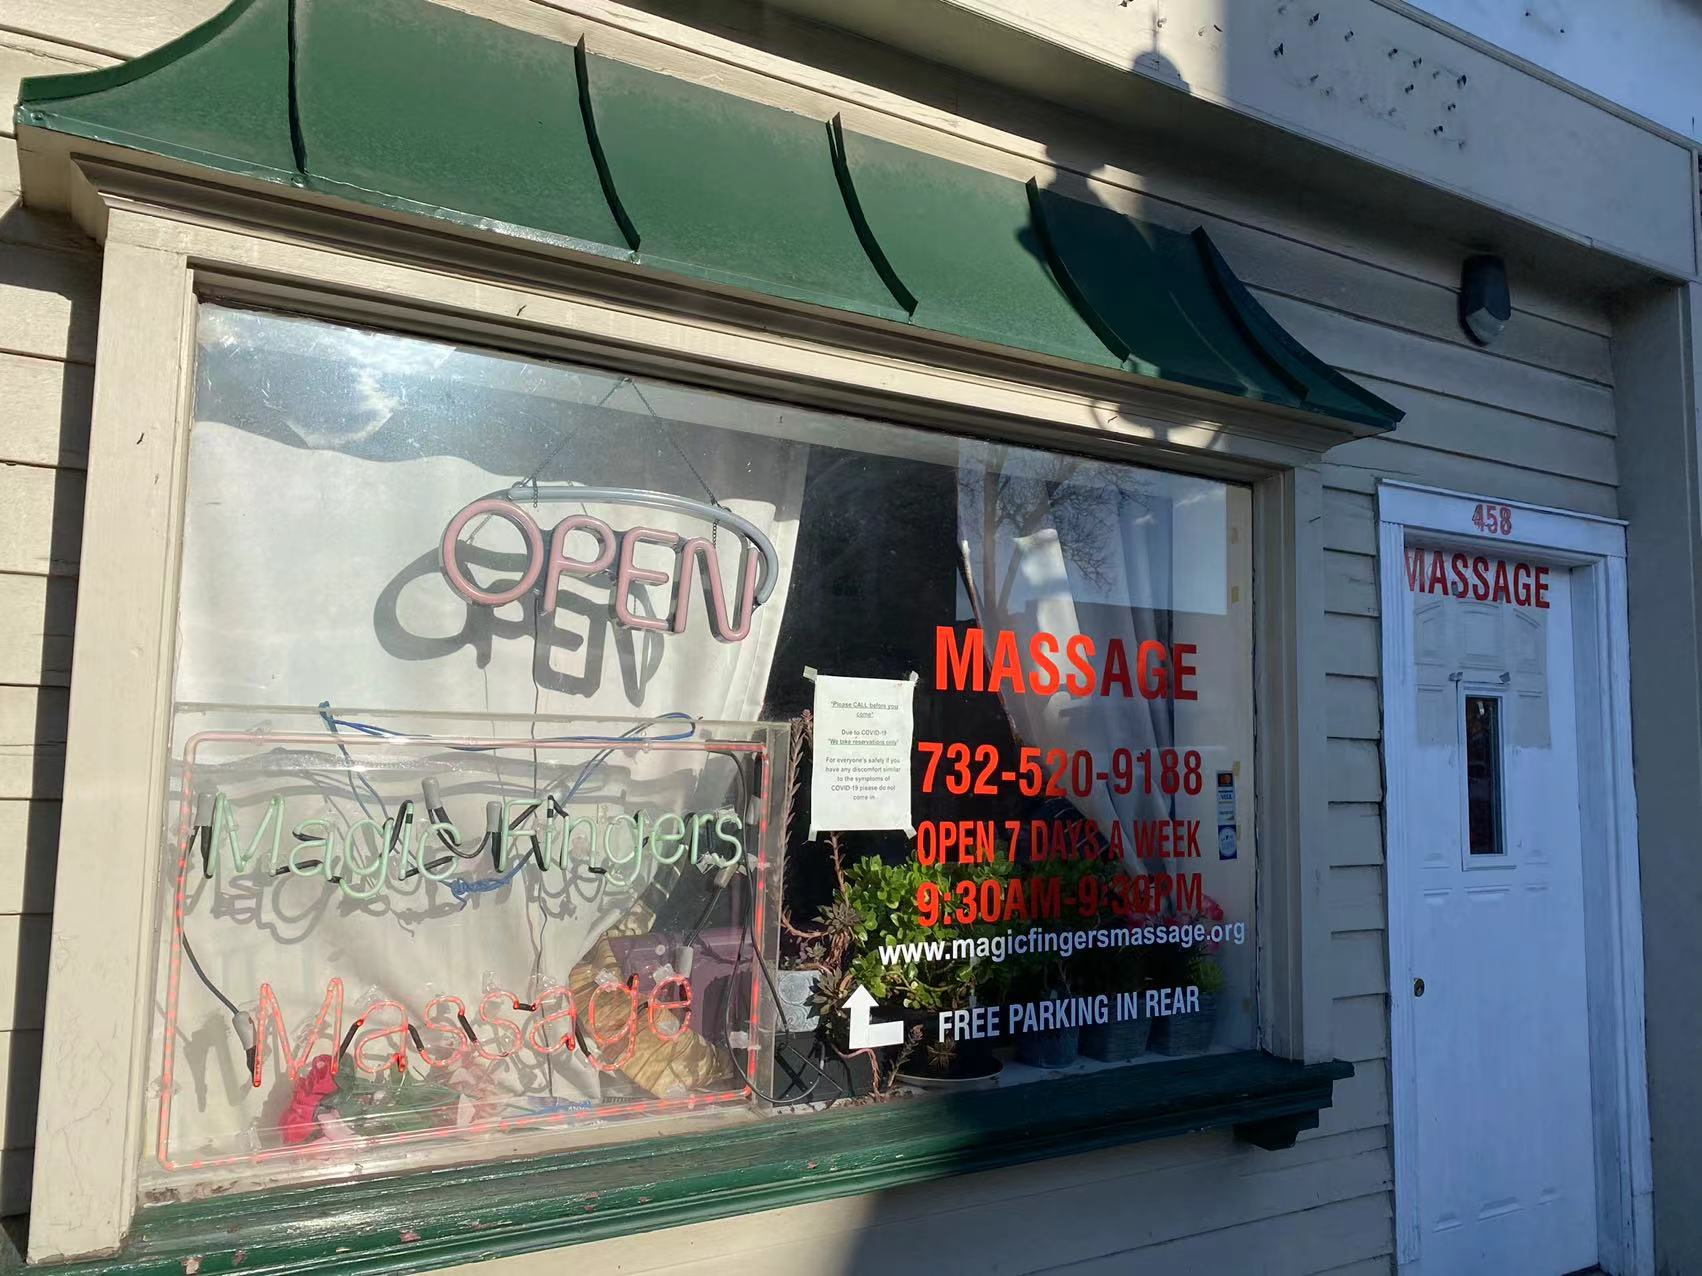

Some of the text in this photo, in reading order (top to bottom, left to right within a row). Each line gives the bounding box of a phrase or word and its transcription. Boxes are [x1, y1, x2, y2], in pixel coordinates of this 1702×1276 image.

[1472, 503, 1513, 536] 458
[440, 498, 760, 642] OPEN
[1404, 547, 1551, 609] MASSAGE
[935, 625, 1199, 700] MASSAGE
[852, 701, 867, 709] CALL
[841, 728, 853, 736] Due
[825, 756, 836, 764] For
[854, 775, 884, 783] symptoms
[917, 741, 1203, 799] 732-520-9188
[859, 784, 878, 792] please
[202, 792, 744, 899] Magic Fingers
[916, 820, 996, 867] OPEN
[1004, 821, 1023, 862] 7
[1030, 819, 1099, 862] DAYS
[1108, 820, 1125, 859] A
[1133, 819, 1201, 859] WEEK
[916, 872, 1203, 928] 9:30AM-9:30PM
[878, 919, 1246, 966] www.magicfingersmassage.org
[253, 977, 694, 1088] Massage
[938, 985, 1201, 1044] FREE PARKING IN REAR
